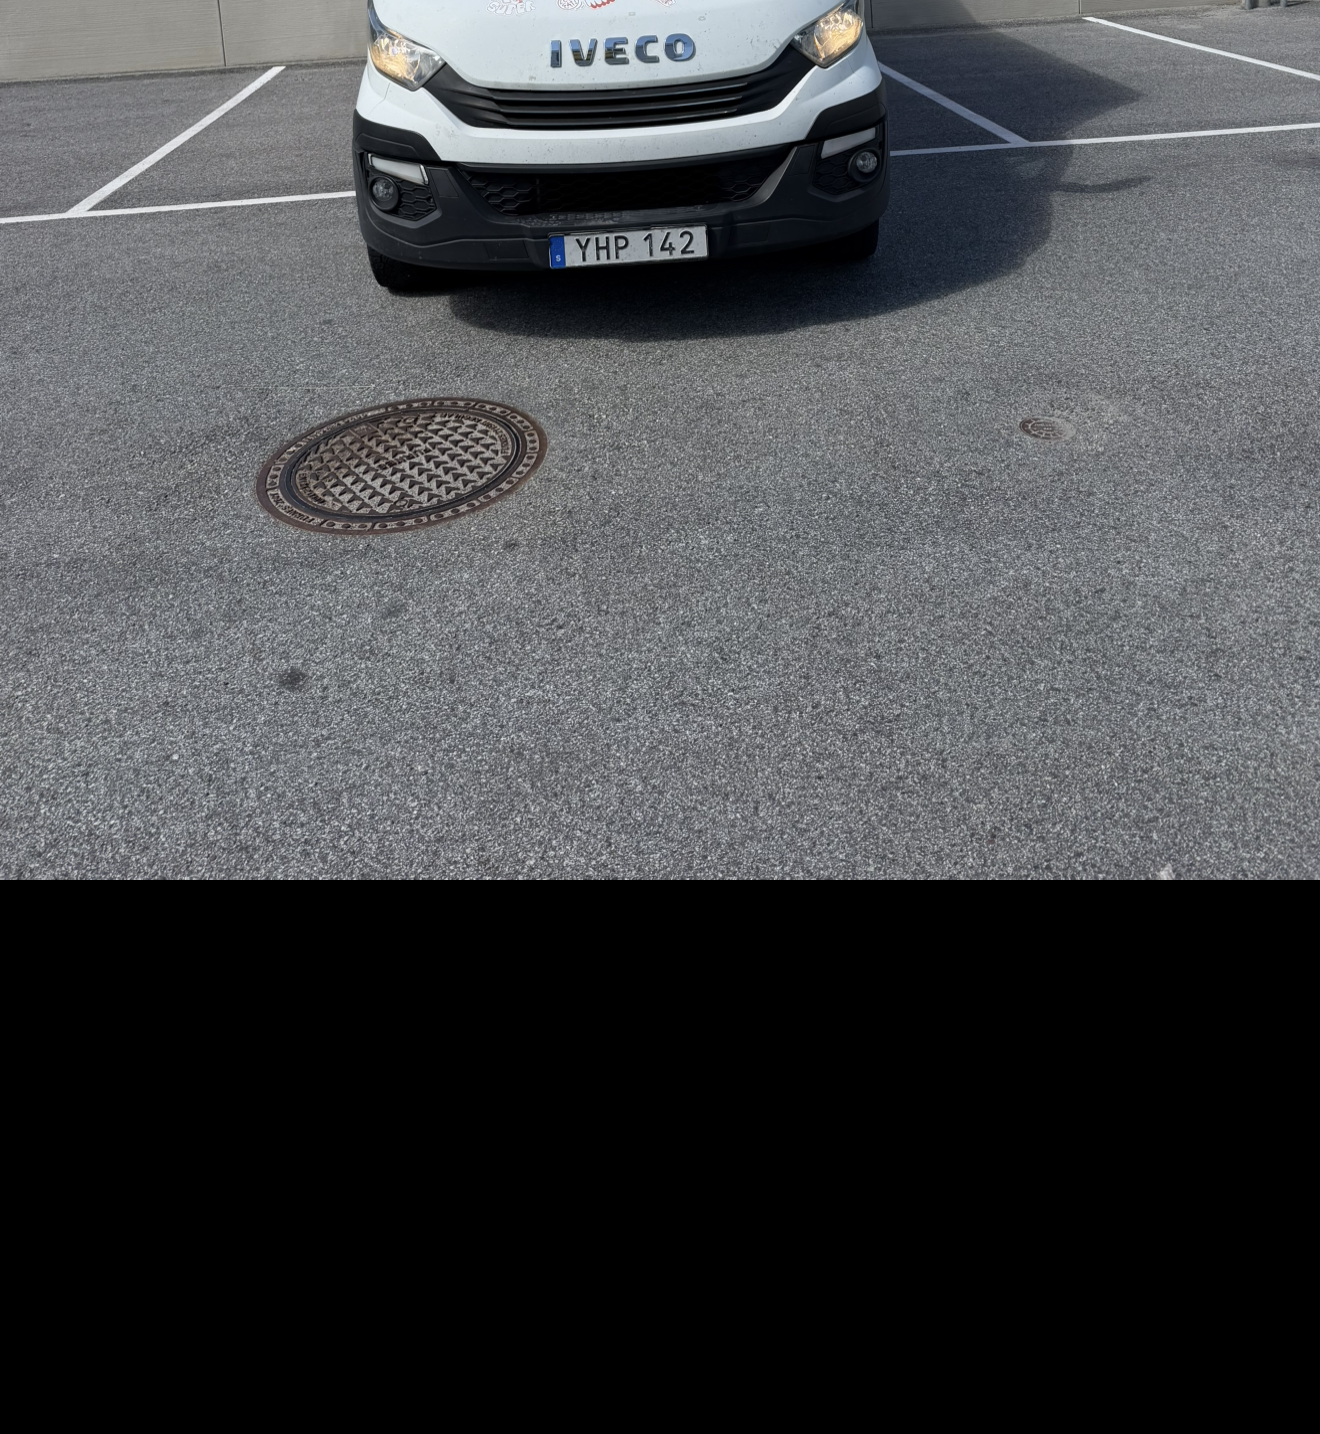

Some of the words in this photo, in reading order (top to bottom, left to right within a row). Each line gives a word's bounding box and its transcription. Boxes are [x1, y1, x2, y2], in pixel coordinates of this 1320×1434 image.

[550, 32, 697, 68] IVECO
[555, 254, 562, 262] S
[575, 235, 630, 262] YHP
[643, 230, 695, 257] 142
